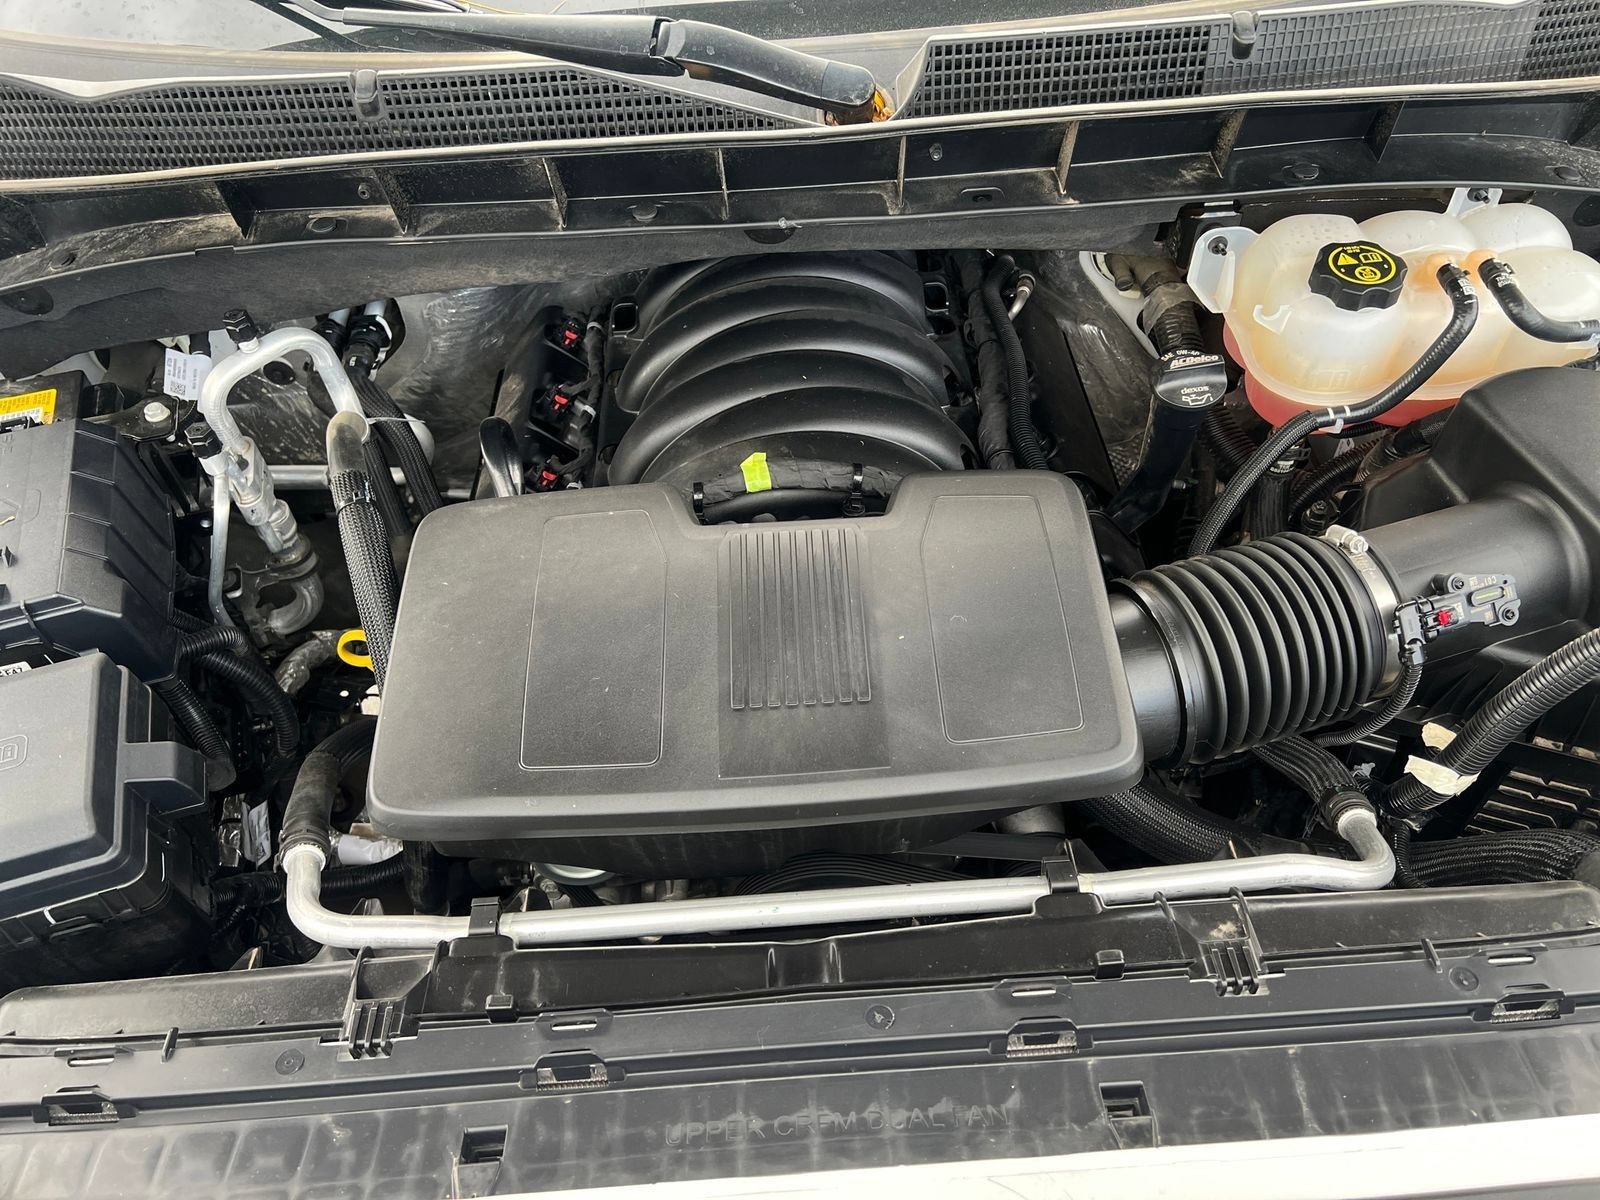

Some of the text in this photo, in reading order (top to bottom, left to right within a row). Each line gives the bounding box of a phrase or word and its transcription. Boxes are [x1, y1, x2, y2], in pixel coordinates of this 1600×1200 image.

[1170, 355, 1218, 370] ACDelco
[1181, 386, 1209, 394] dexos
[665, 1117, 766, 1146] UPPER
[867, 1107, 946, 1130] DUAL
[950, 1103, 1010, 1129] FAN
